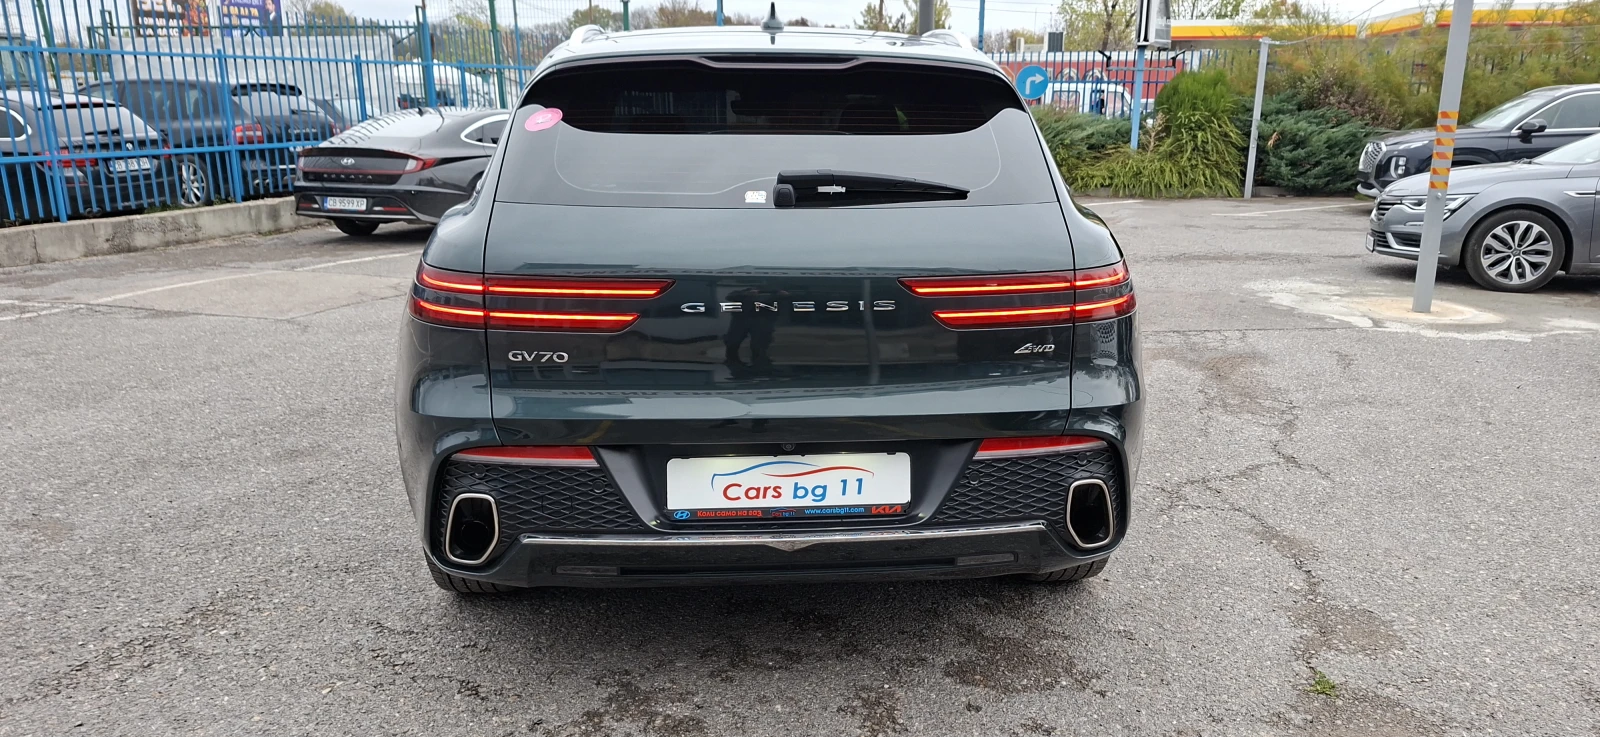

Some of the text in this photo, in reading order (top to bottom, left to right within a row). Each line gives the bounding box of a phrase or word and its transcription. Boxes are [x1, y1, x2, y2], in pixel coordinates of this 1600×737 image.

[338, 198, 355, 208] 9599
[680, 300, 896, 313] GENESIS
[508, 350, 569, 363] GV70
[722, 477, 864, 503] Cars bg 11
[804, 507, 865, 515] www.carsbg11.com
